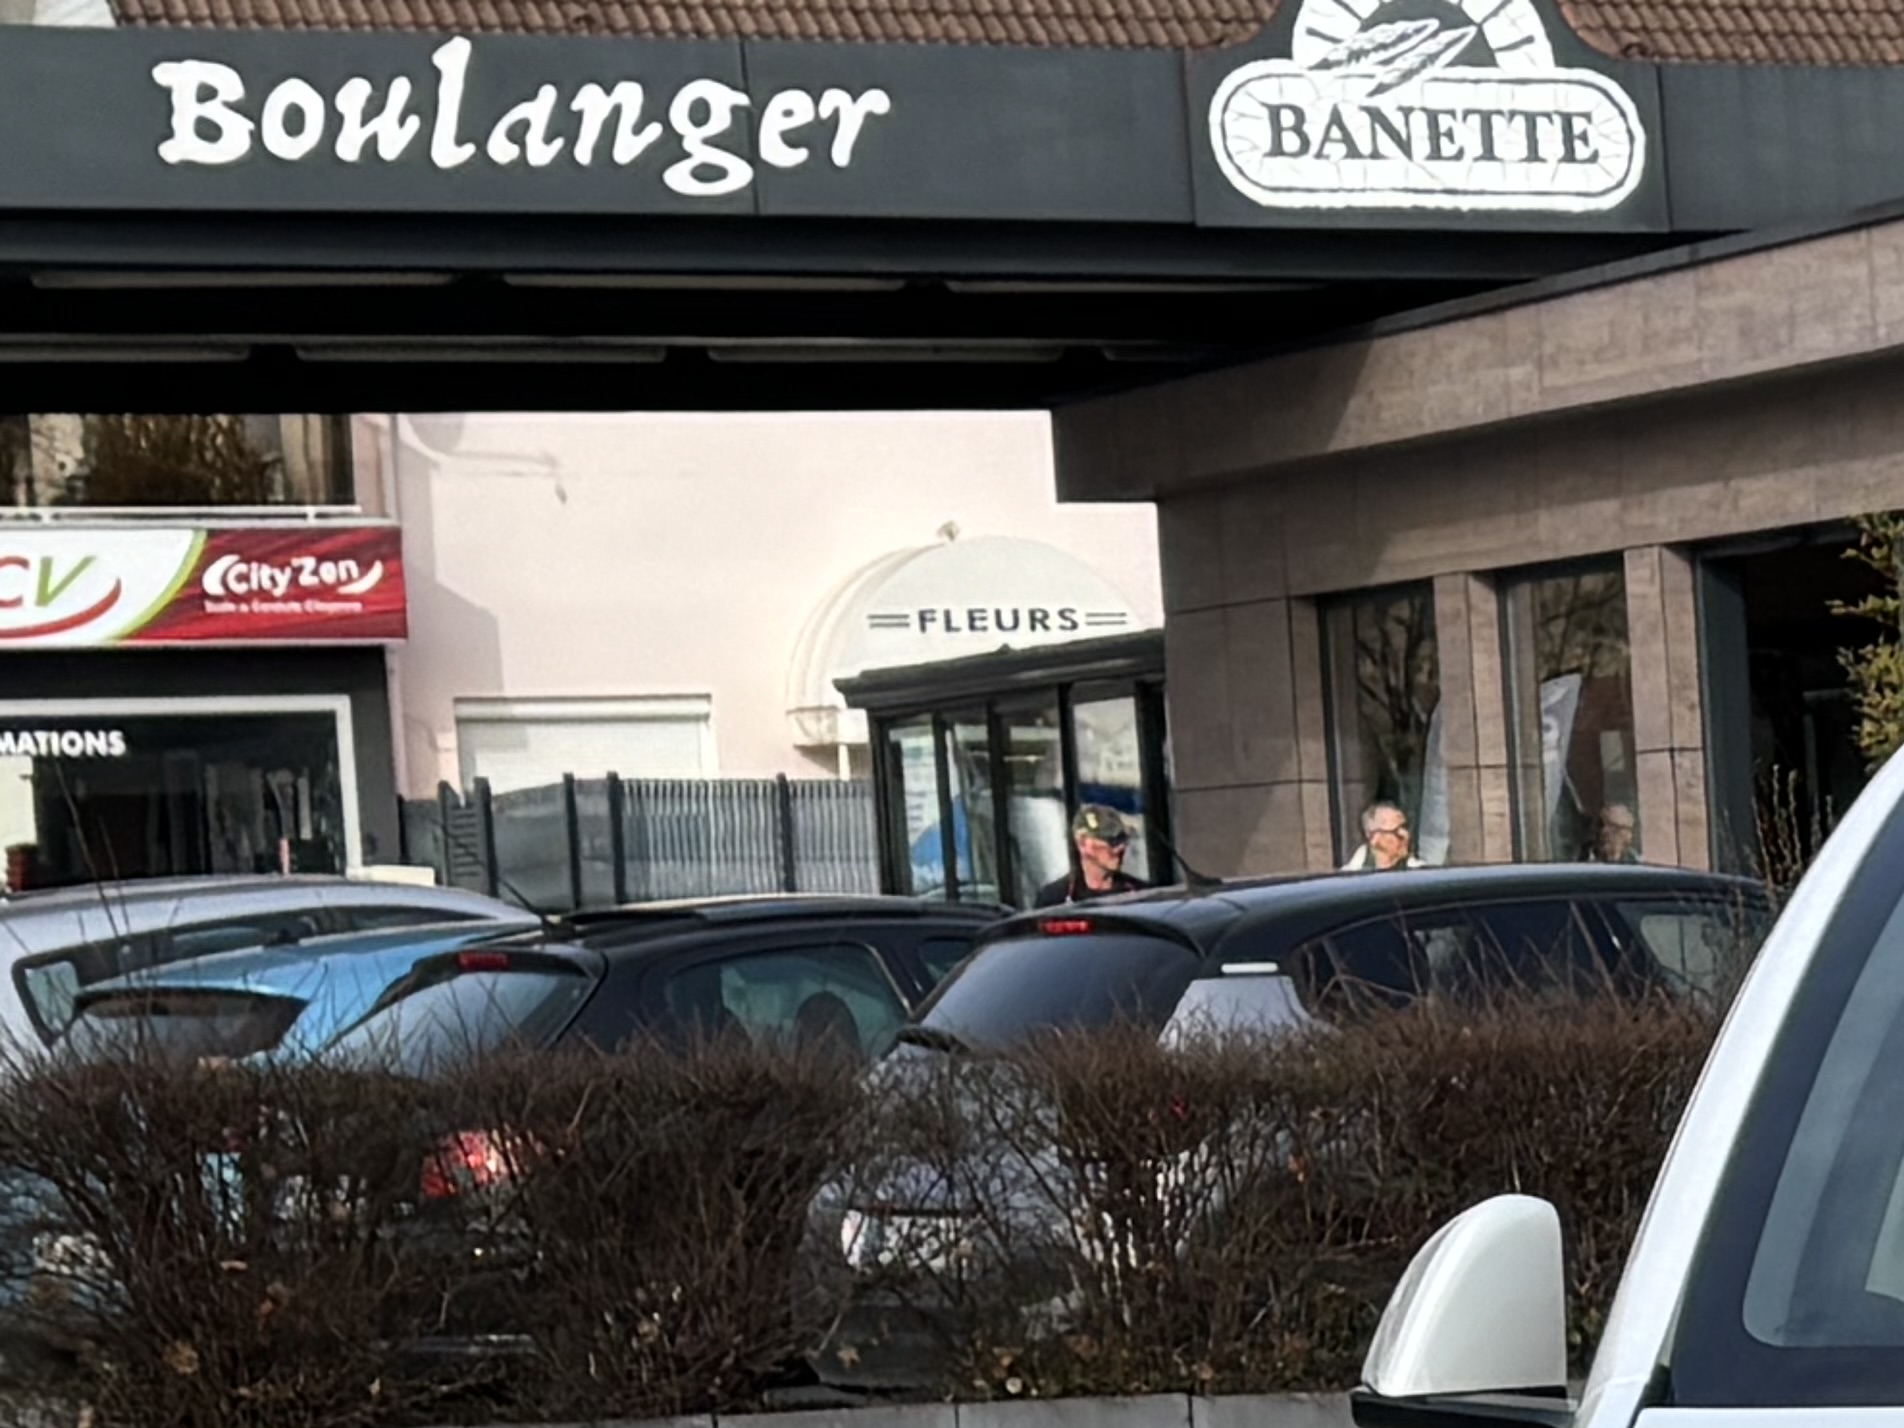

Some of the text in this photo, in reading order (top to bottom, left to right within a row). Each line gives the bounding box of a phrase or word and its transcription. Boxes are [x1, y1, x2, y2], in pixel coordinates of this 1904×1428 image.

[151, 36, 891, 196] Boulanger
[1261, 102, 1600, 165] BANETTE
[917, 607, 1080, 634] FLEURS
